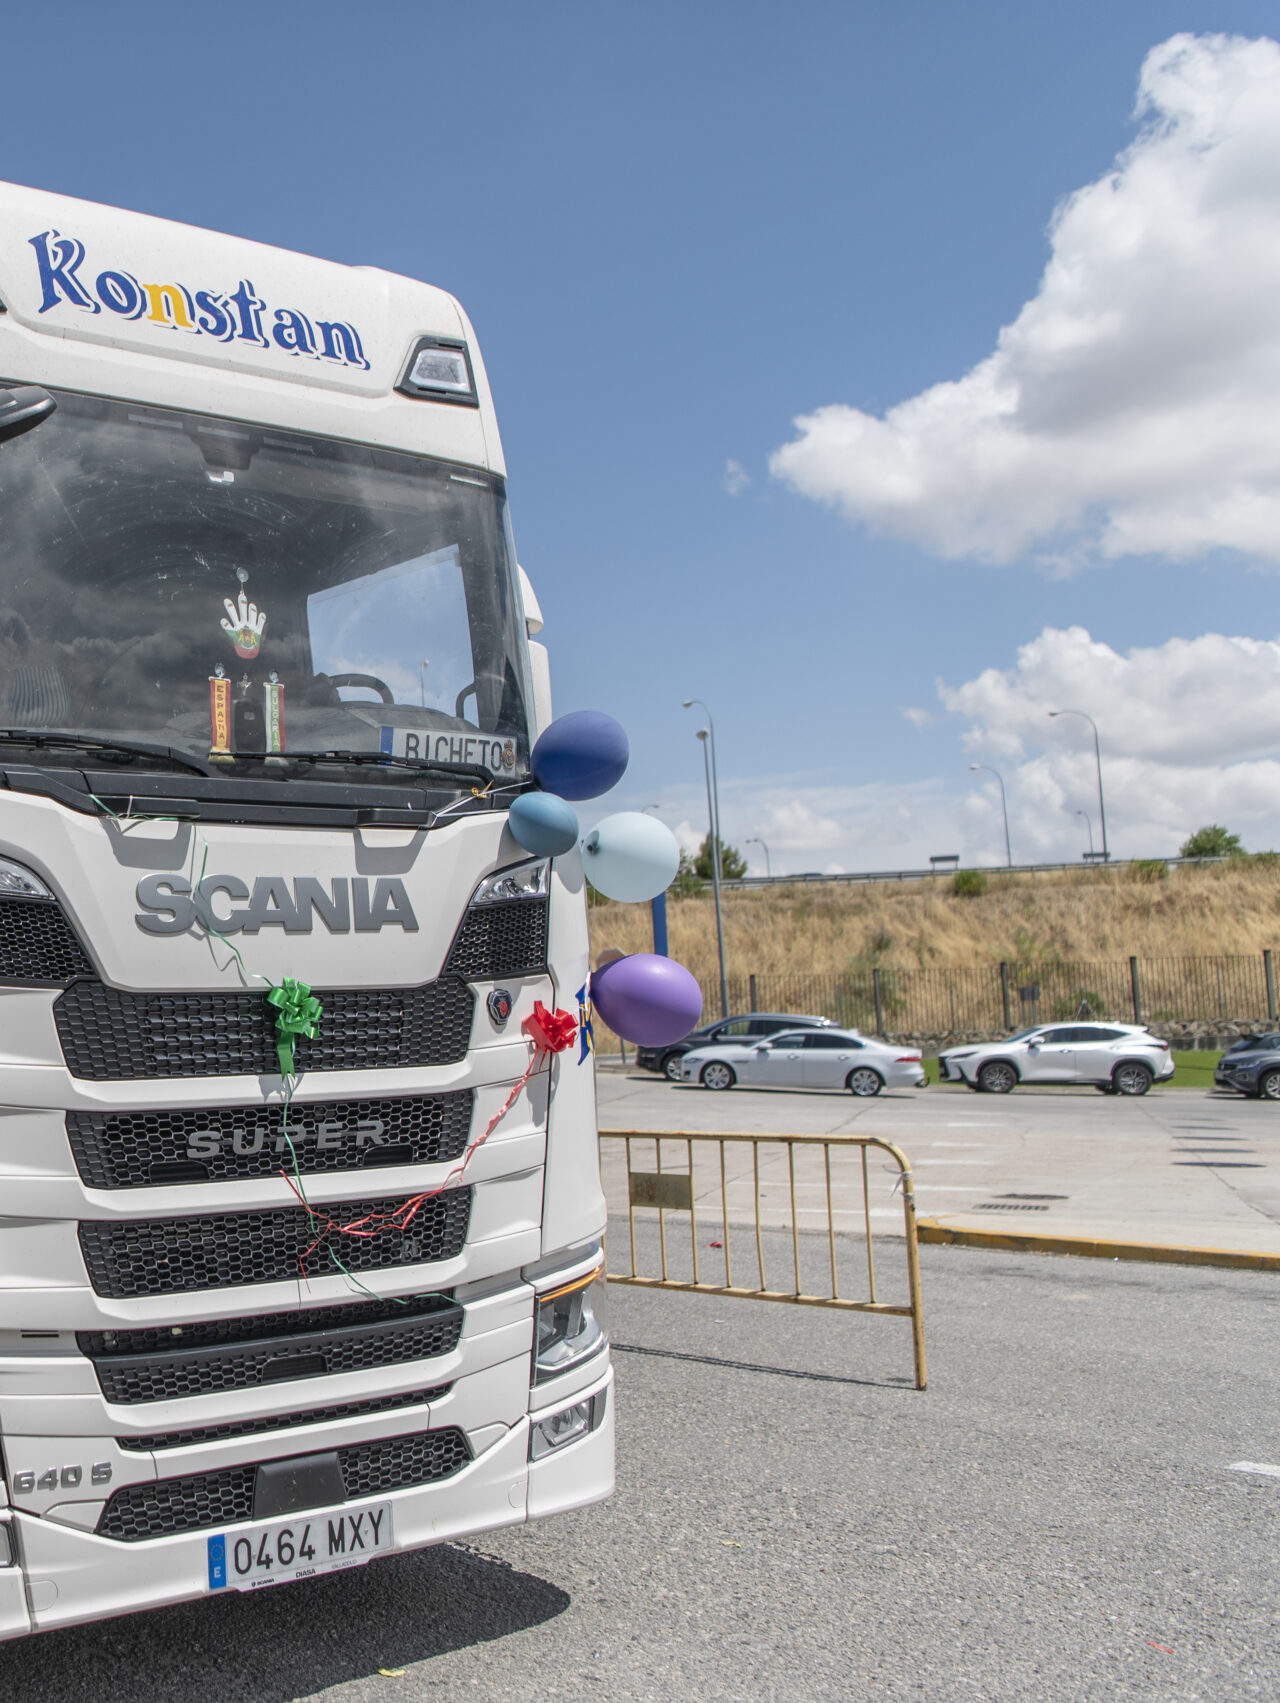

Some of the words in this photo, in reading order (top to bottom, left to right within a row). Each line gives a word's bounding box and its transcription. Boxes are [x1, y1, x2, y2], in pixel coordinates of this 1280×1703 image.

[28, 229, 370, 370] Konstan
[271, 690, 280, 747] BULGARIA
[134, 873, 420, 935] SCANIA
[187, 1120, 384, 1158] SUPER
[13, 1465, 82, 1495] 640
[234, 1524, 316, 1575] 0464
[328, 1509, 384, 1556] MXY
[213, 1566, 222, 1578] E
[295, 1568, 317, 1578] DIASA
